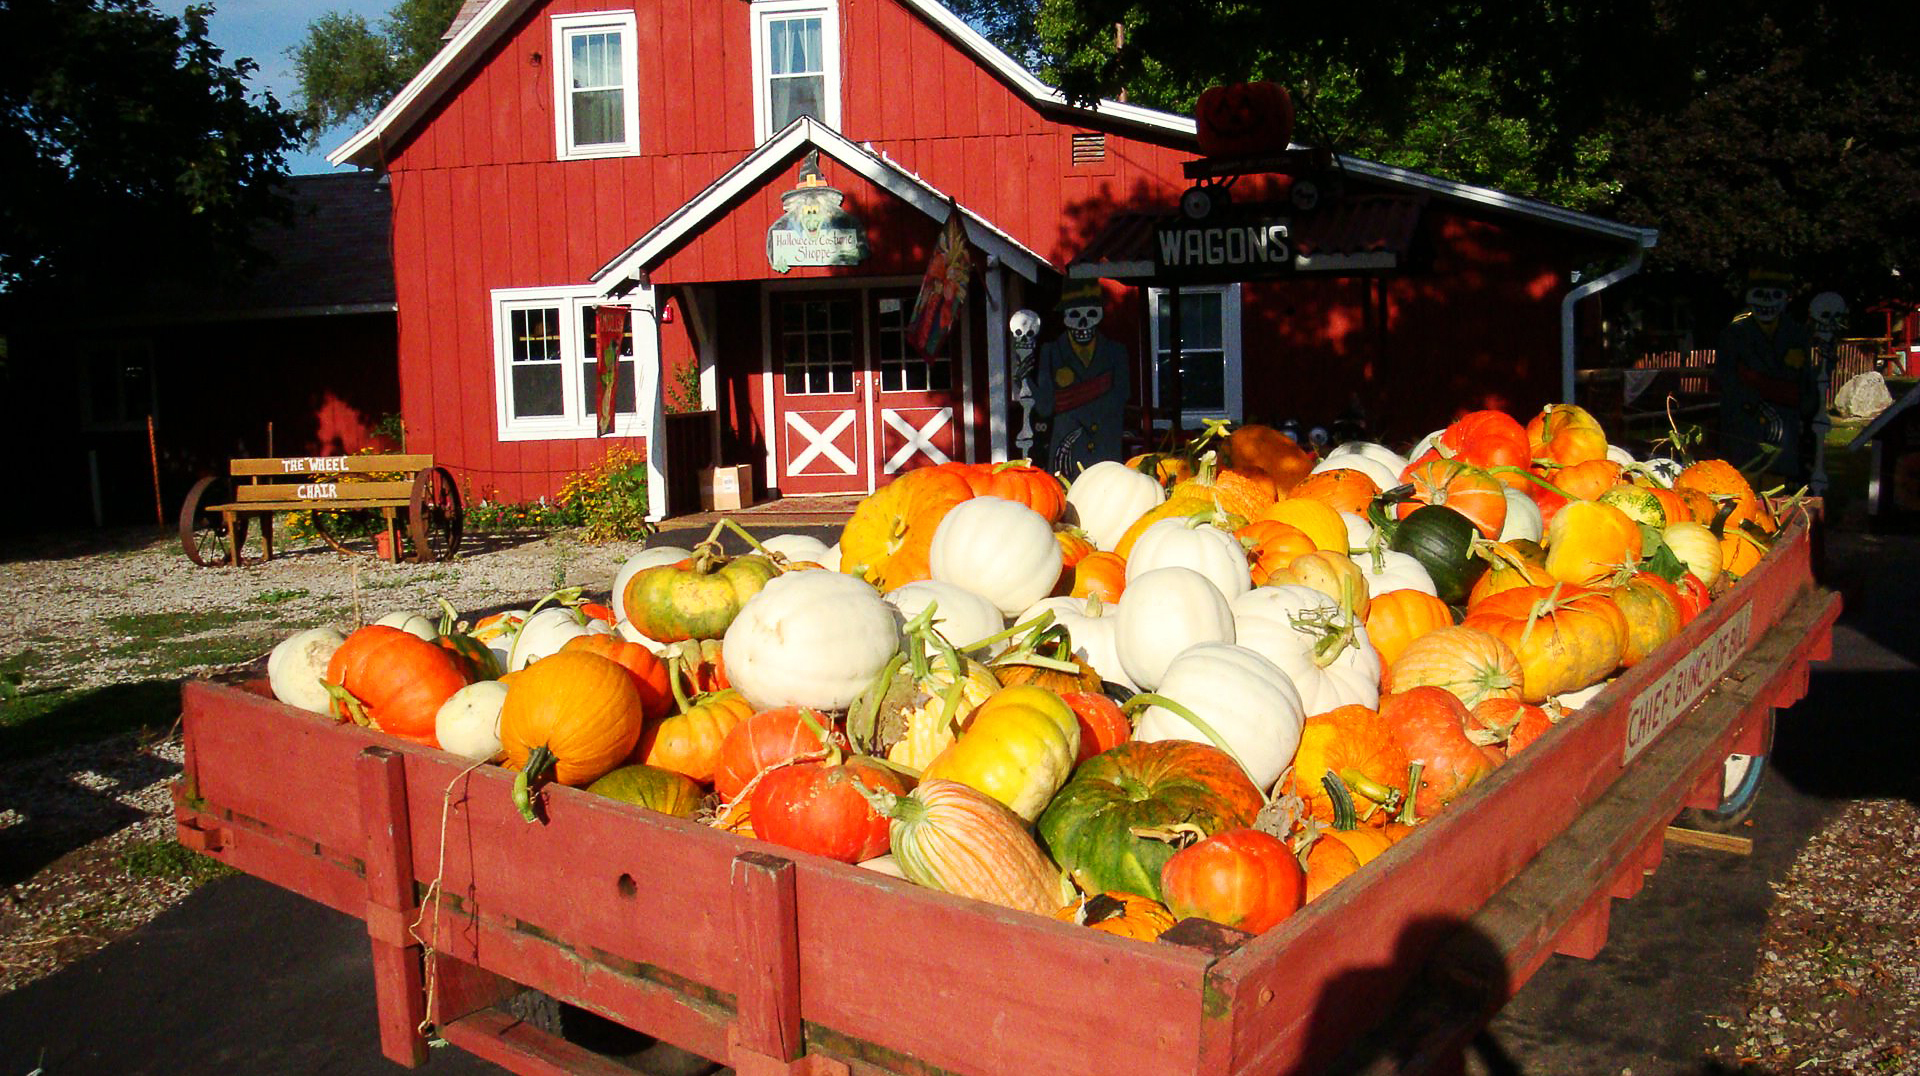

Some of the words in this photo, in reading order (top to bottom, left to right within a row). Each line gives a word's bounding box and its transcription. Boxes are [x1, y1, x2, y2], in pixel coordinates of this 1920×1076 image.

[776, 231, 817, 247] Halloween
[819, 230, 852, 246] Costume
[1158, 225, 1289, 266] WAGONS
[281, 459, 305, 473] THE
[305, 455, 350, 472] WHEEL
[297, 483, 338, 499] CHAIR
[1628, 682, 1671, 748] CHIEF
[1674, 649, 1713, 709] BUNCH
[1715, 633, 1728, 671] OF
